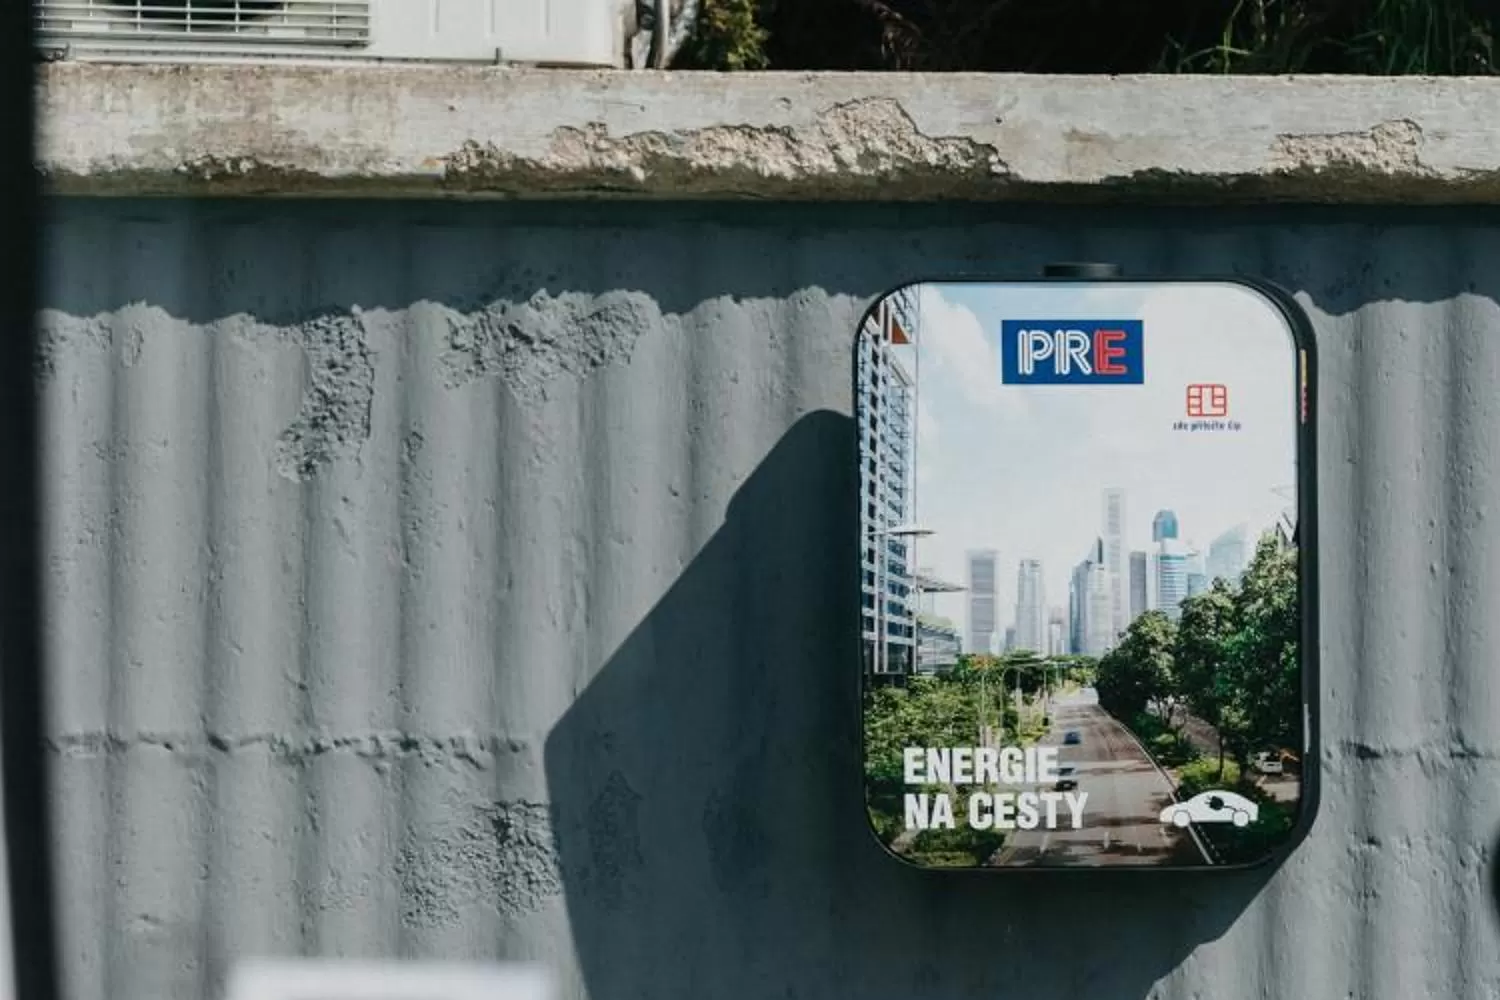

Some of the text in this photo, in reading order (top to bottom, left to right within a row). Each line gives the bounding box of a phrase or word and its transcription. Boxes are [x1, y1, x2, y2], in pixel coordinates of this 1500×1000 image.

[1017, 328, 1128, 375] PRE
[903, 747, 1060, 785] ENERGIE
[904, 791, 1089, 830] NA CESTY
